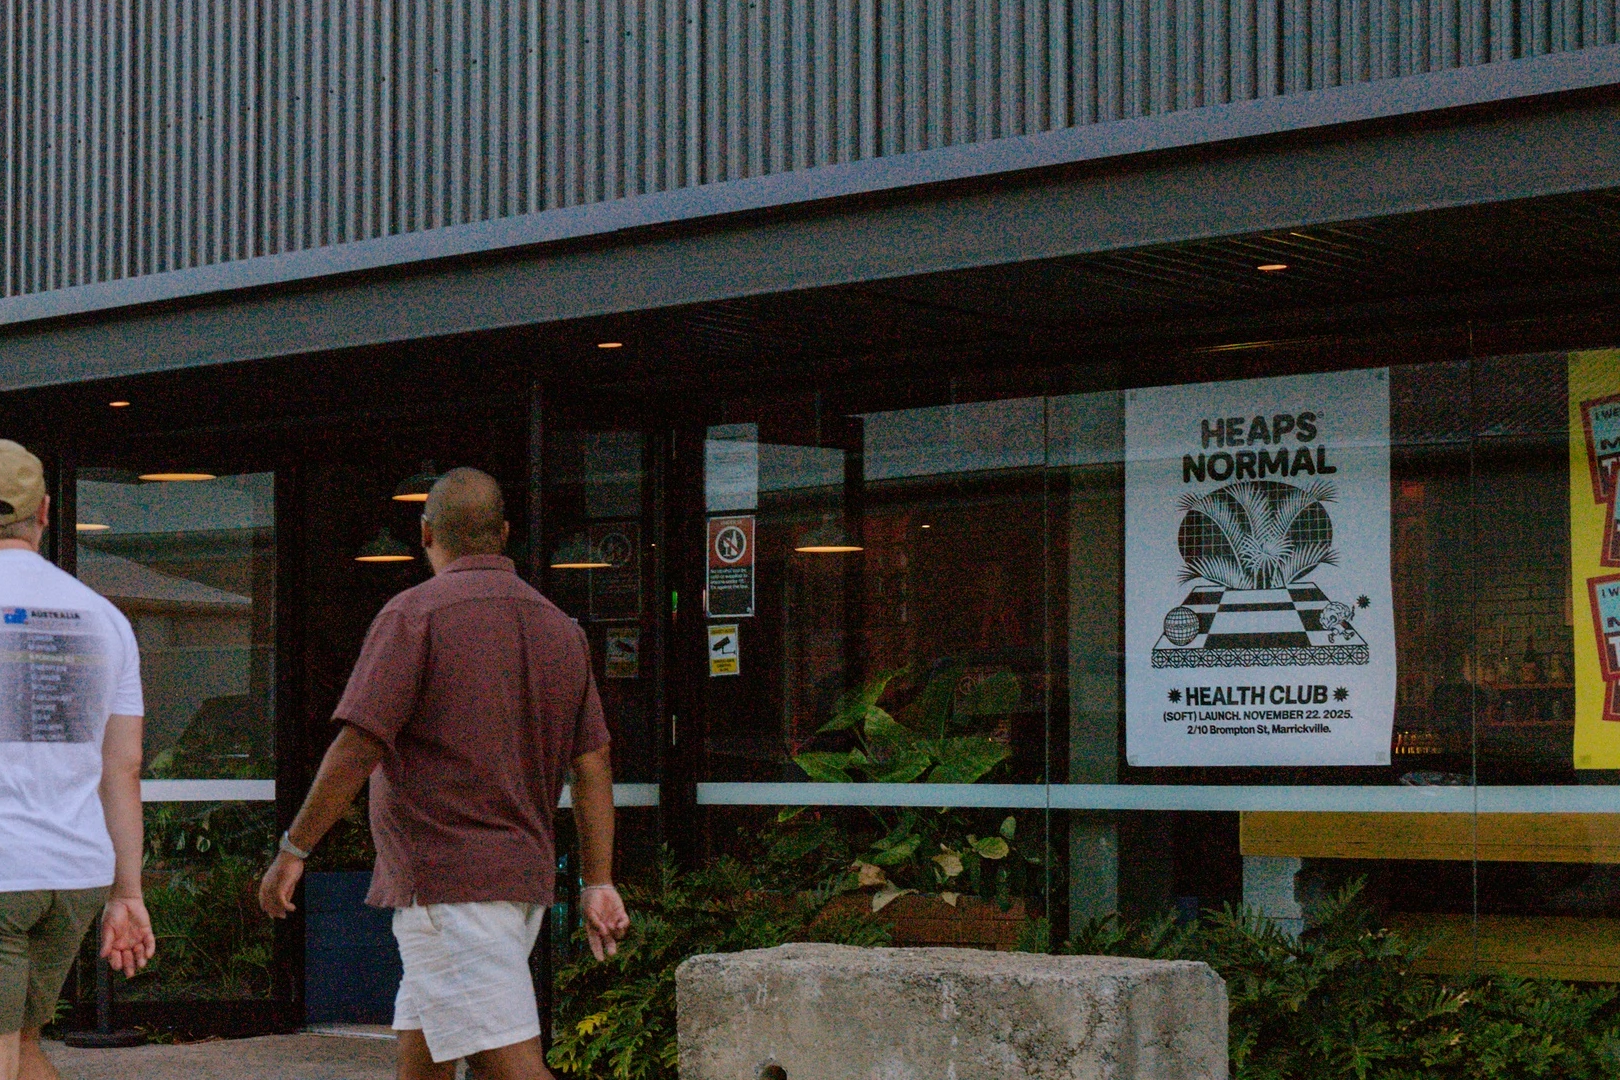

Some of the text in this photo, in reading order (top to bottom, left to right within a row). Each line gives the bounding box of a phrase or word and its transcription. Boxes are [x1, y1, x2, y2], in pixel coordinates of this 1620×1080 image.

[1200, 411, 1318, 449] HEAPS
[1182, 444, 1338, 483] NORMAL
[31, 610, 80, 620] AUSTRALIA
[1185, 685, 1329, 706] HEALTH CLUB
[1163, 709, 1353, 723] (SOFT) LAUNCH. NOVEMBER 22. 2025.
[1187, 724, 1331, 736] 2/10 Brompton St, Marrickville.
